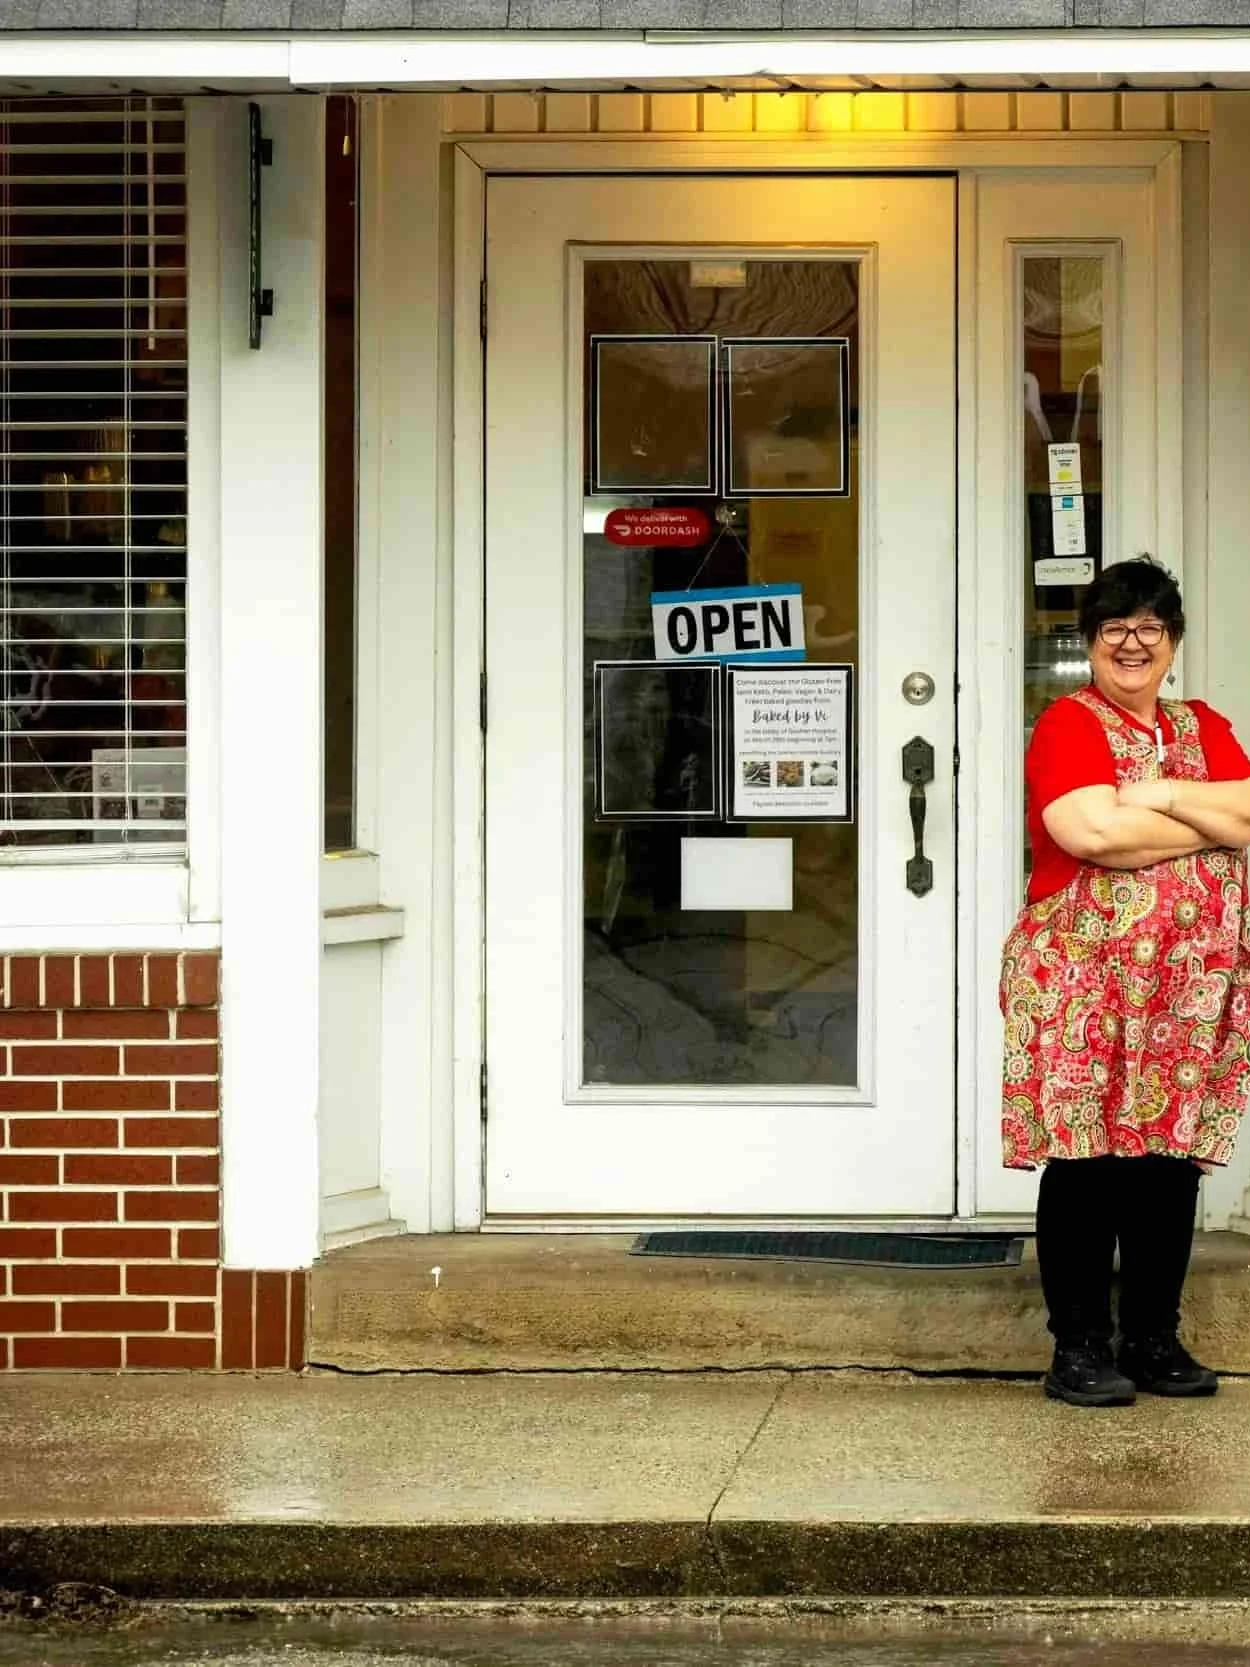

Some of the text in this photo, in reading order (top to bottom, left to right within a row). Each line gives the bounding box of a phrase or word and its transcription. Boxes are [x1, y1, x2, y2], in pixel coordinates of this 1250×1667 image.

[634, 526, 700, 537] DOORDASH
[667, 599, 791, 655] OPEN
[736, 679, 756, 687] Come
[752, 709, 790, 724] Baked
[794, 709, 810, 725] by
